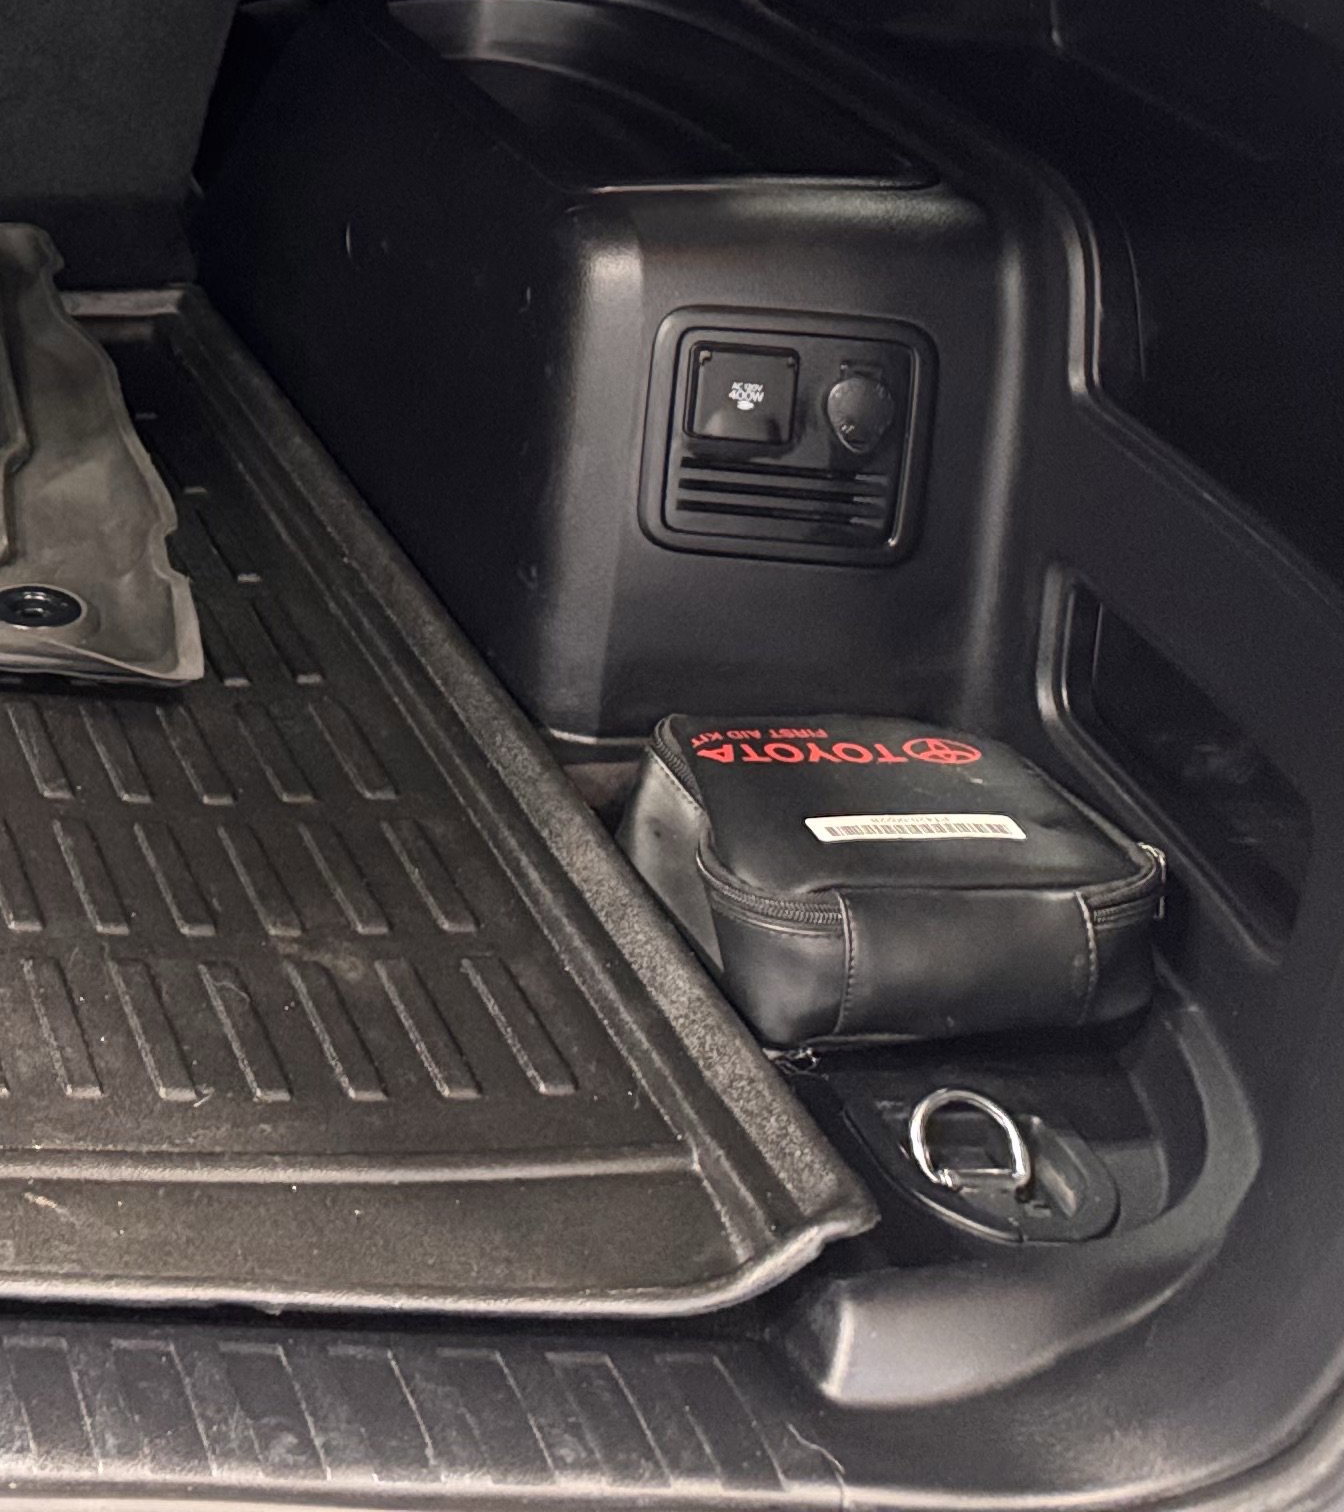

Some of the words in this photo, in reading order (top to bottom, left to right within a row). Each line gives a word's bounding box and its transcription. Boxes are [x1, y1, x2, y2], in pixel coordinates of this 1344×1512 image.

[729, 389, 764, 402] 400W
[692, 733, 723, 747] KIT
[727, 730, 761, 740] AID
[769, 729, 827, 738] FIRST
[698, 743, 908, 763] TOYOTA
